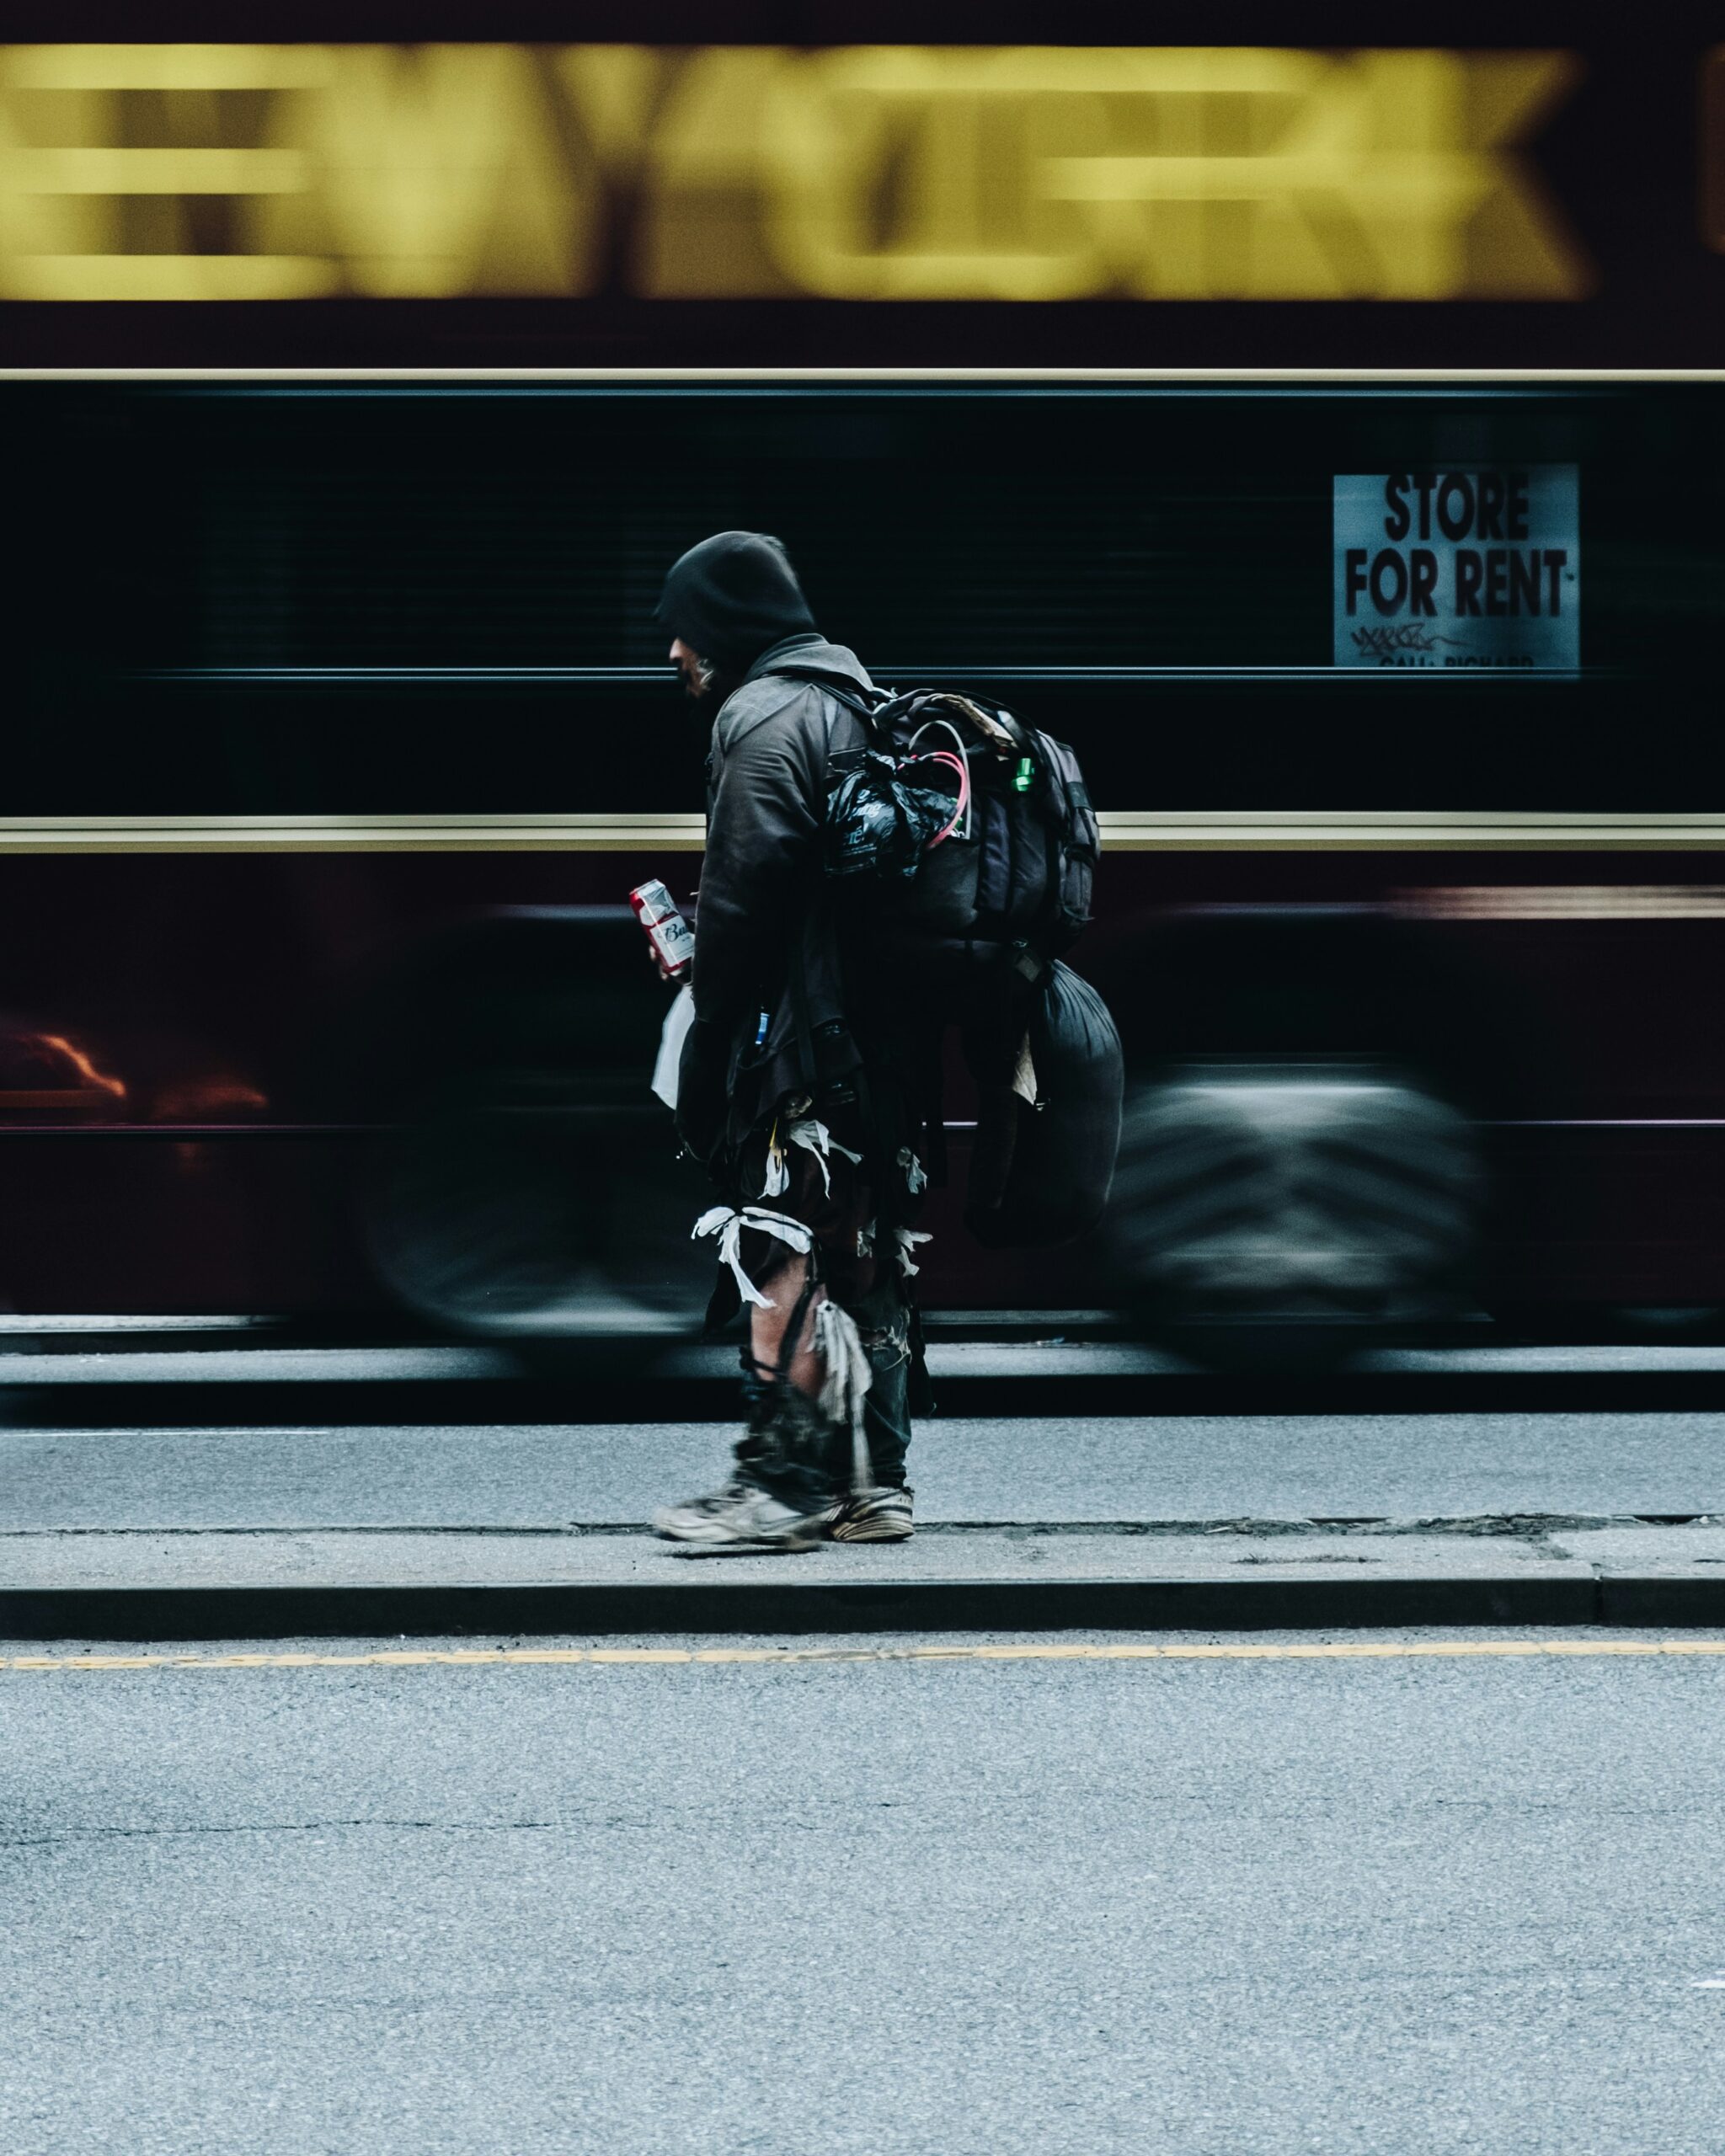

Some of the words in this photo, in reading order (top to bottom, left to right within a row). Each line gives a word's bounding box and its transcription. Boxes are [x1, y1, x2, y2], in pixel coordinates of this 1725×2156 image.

[1384, 472, 1530, 542] STORE
[1345, 547, 1438, 617] FOR
[1455, 548, 1567, 617] RENT
